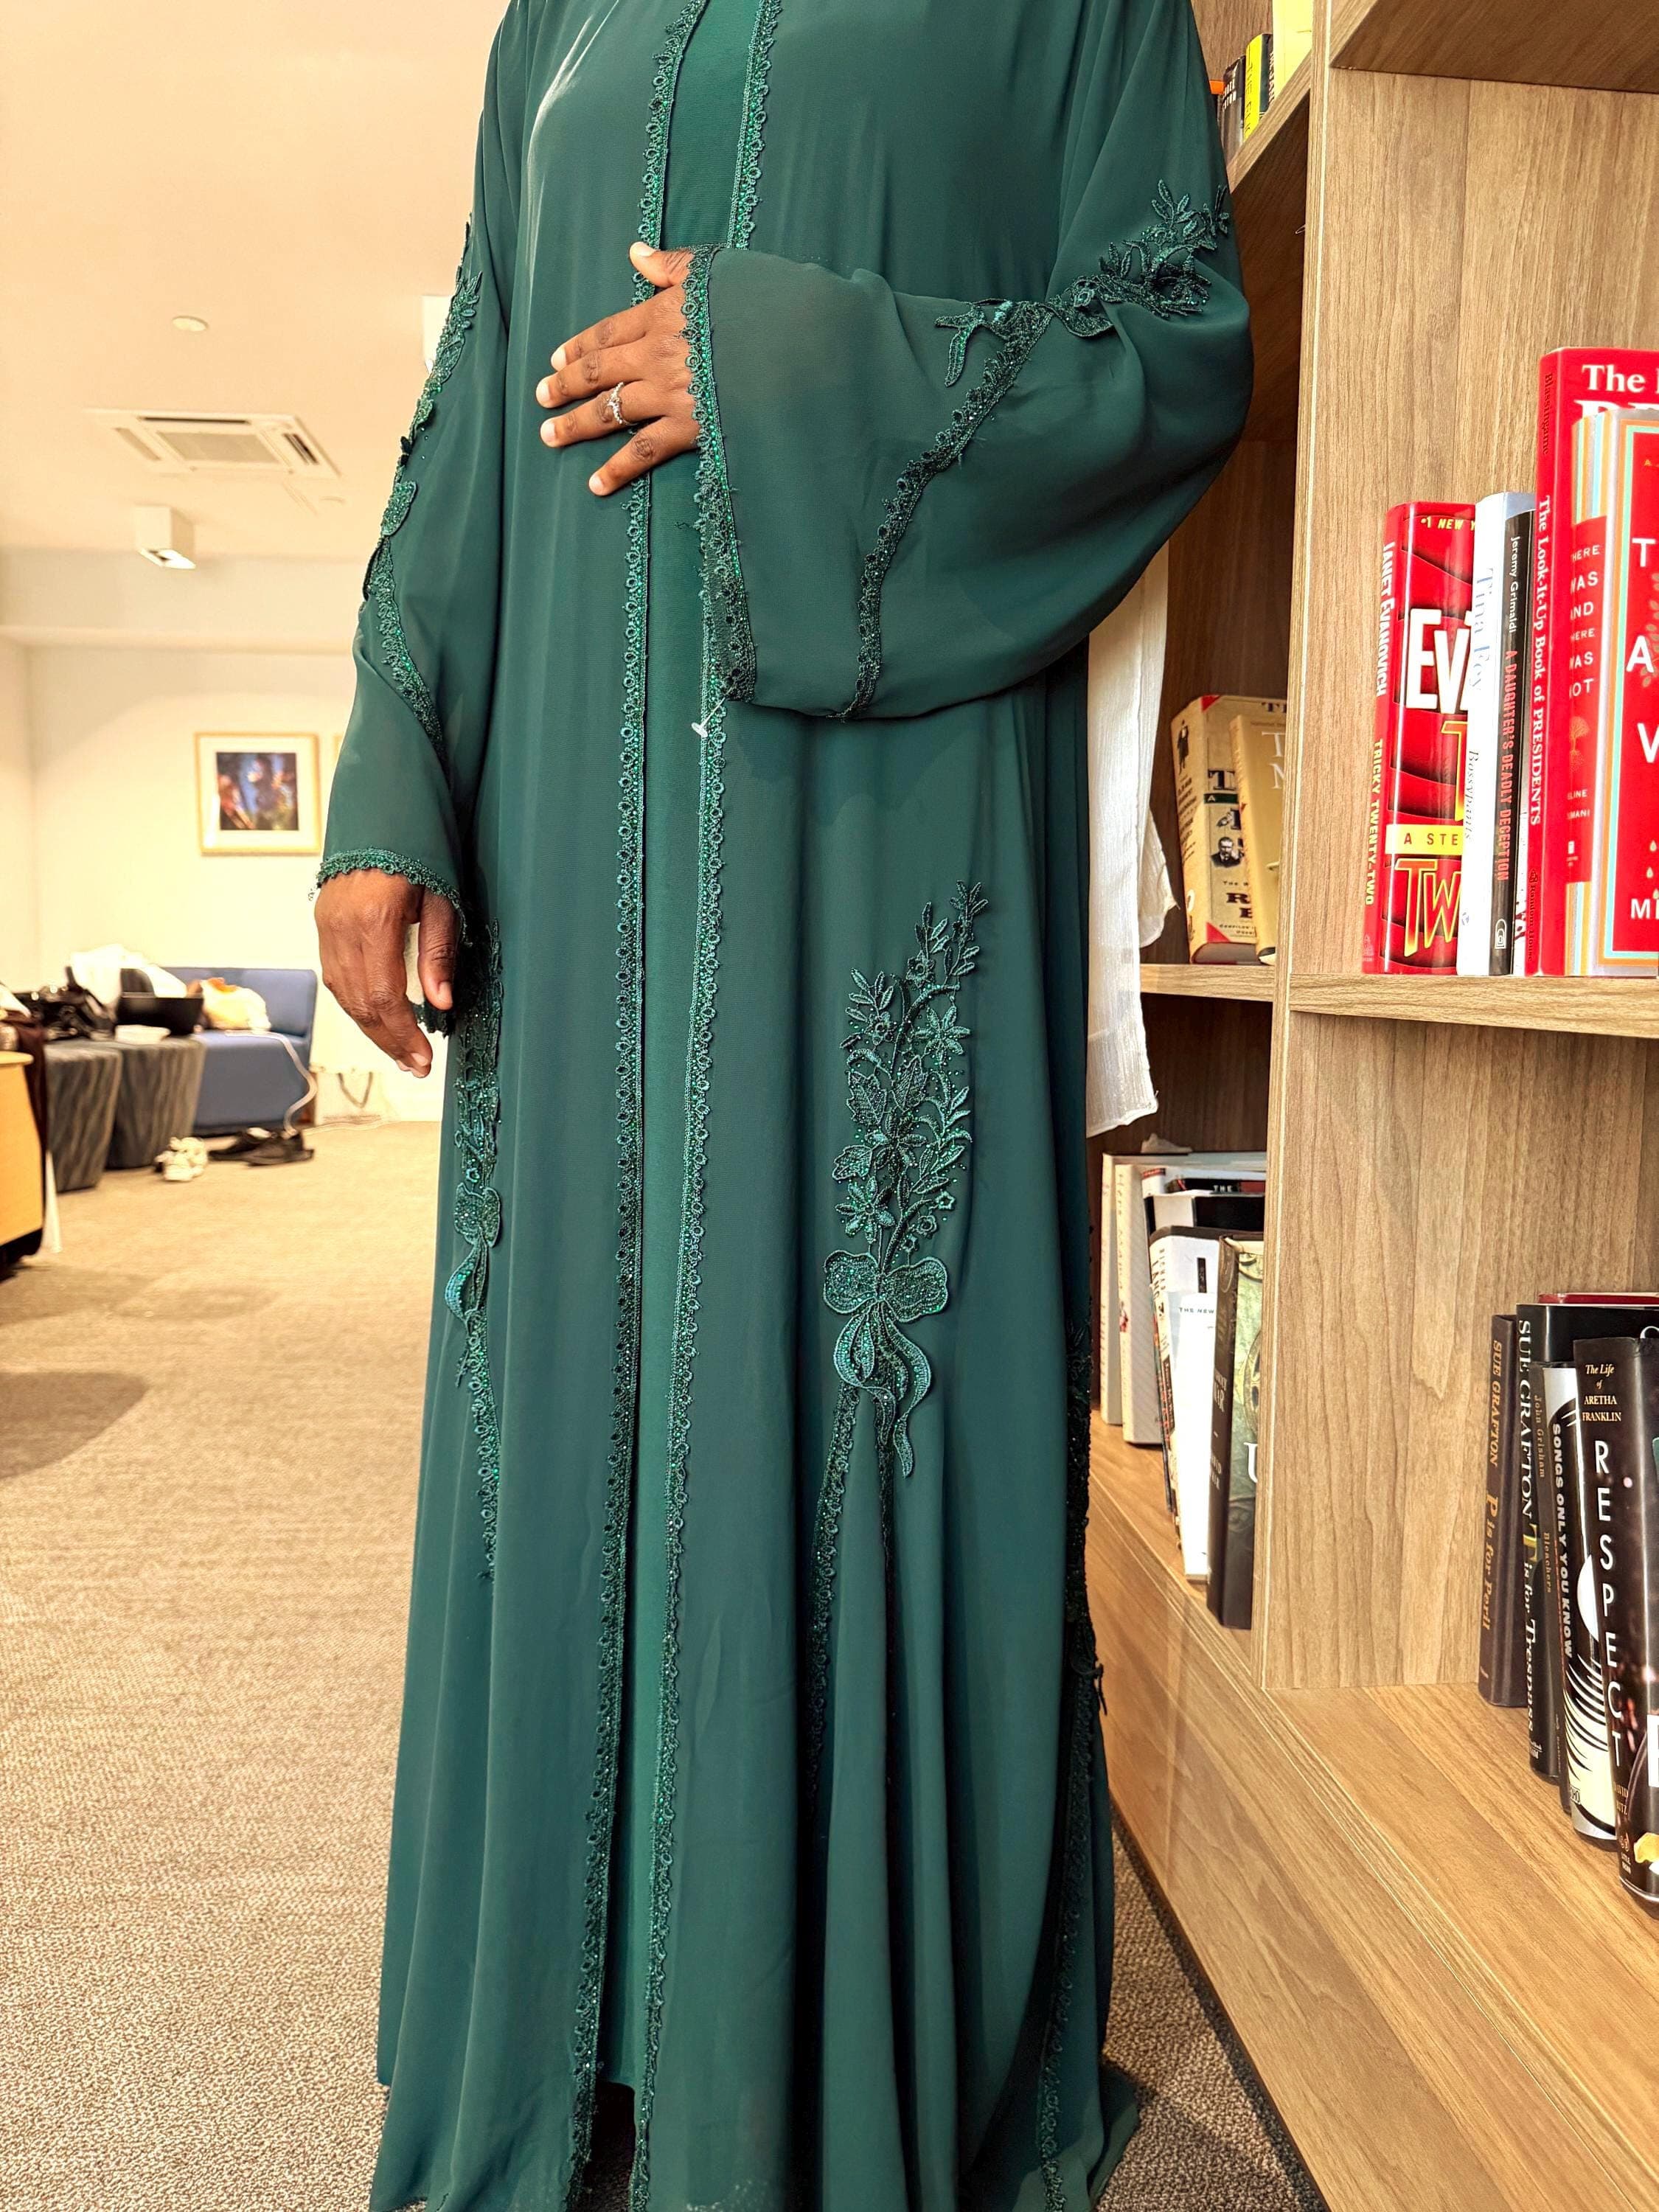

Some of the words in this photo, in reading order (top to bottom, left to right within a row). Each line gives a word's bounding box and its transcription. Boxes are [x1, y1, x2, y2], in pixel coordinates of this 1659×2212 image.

[1582, 364, 1646, 393] The
[1438, 518, 1464, 529] NEW
[1538, 495, 1551, 532] The
[1381, 542, 1396, 597] JANET
[1509, 536, 1521, 578] Jeremy
[1571, 544, 1600, 561] HERE
[1534, 537, 1549, 632] Look-It-Up
[1509, 581, 1519, 633] Grimaldi
[1377, 598, 1395, 697] EVANOVICH
[1506, 650, 1517, 659] A
[1532, 634, 1546, 674] Book
[1502, 663, 1517, 750] DAUGHTER'S
[1533, 686, 1545, 703] of
[1371, 739, 1383, 794] TRICKY
[1500, 753, 1515, 804] DEADLY
[1531, 709, 1545, 826] PRESIDENTS
[1366, 799, 1380, 906] TWENTY-TWO
[1404, 834, 1412, 845] A
[1497, 807, 1512, 881] DECEPTION
[1492, 1340, 1502, 1376] SUE
[1519, 1319, 1531, 1373] SUE
[1585, 1365, 1599, 1374] The
[1600, 1363, 1615, 1377] Life
[1596, 1380, 1603, 1390] of
[1534, 1395, 1543, 1425] John
[1582, 1412, 1621, 1422] FRANKLIN
[1584, 1395, 1617, 1405] ARETHA
[1488, 1380, 1502, 1467] GRAFTON
[1520, 1376, 1532, 1519] GRAFTON
[1537, 1427, 1545, 1478] Grisham
[1553, 1423, 1563, 1488] SONGS
[1485, 1489, 1498, 1517] P
[1555, 1490, 1566, 1547] ONLY
[1486, 1519, 1495, 1537] is
[1522, 1523, 1538, 1562] T
[1484, 1541, 1493, 1575] for
[1523, 1562, 1532, 1577] is
[1543, 1532, 1552, 1593] Bleachers
[1560, 1552, 1570, 1593] YOU
[1482, 1577, 1493, 1630] Peril
[1525, 1582, 1534, 1614] for
[1594, 1440, 1623, 1767] RESPECT
[1562, 1596, 1572, 1658] KNOW
[1526, 1619, 1536, 1731] Trespass
